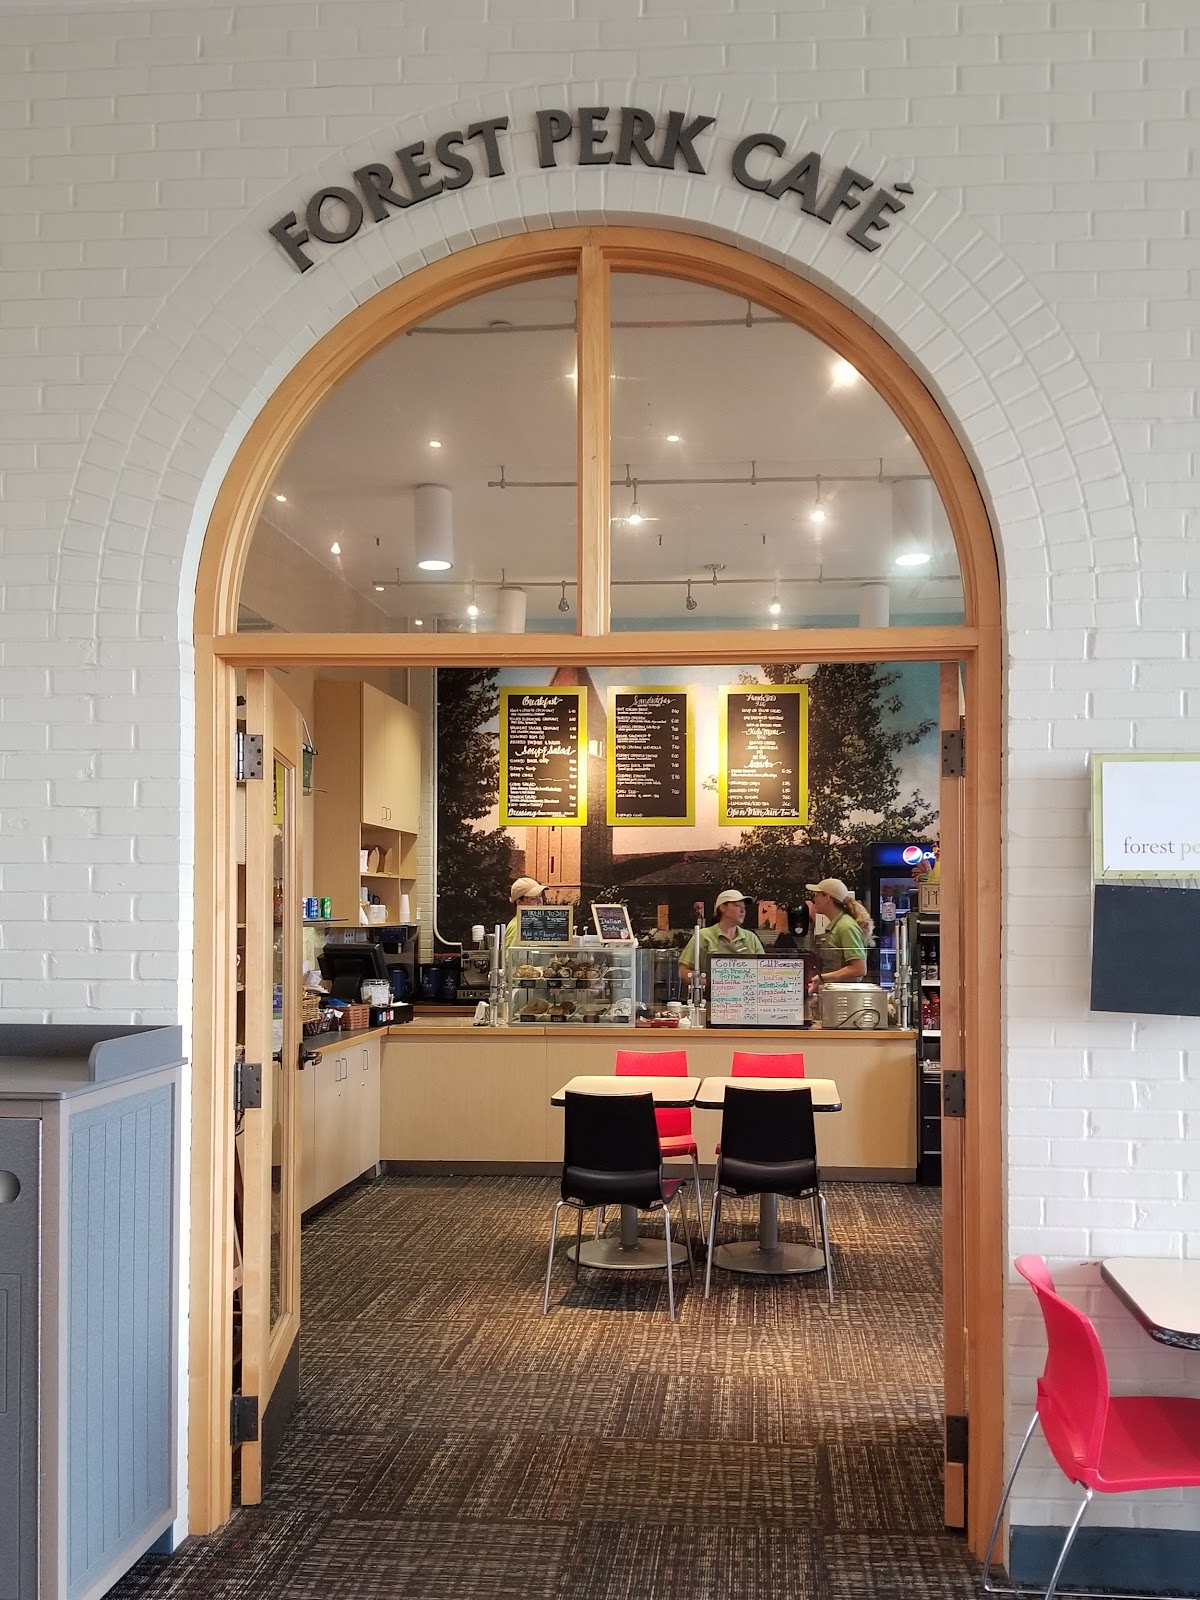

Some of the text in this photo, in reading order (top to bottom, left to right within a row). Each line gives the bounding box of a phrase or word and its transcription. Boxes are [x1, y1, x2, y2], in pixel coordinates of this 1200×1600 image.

[268, 106, 914, 274] FOREST PERK CAFÉ
[522, 696, 564, 708] Breakfast
[629, 695, 676, 708] Sandwiches
[546, 745, 576, 756] Salad
[1124, 836, 1176, 854] forest
[716, 959, 747, 967] Coffee
